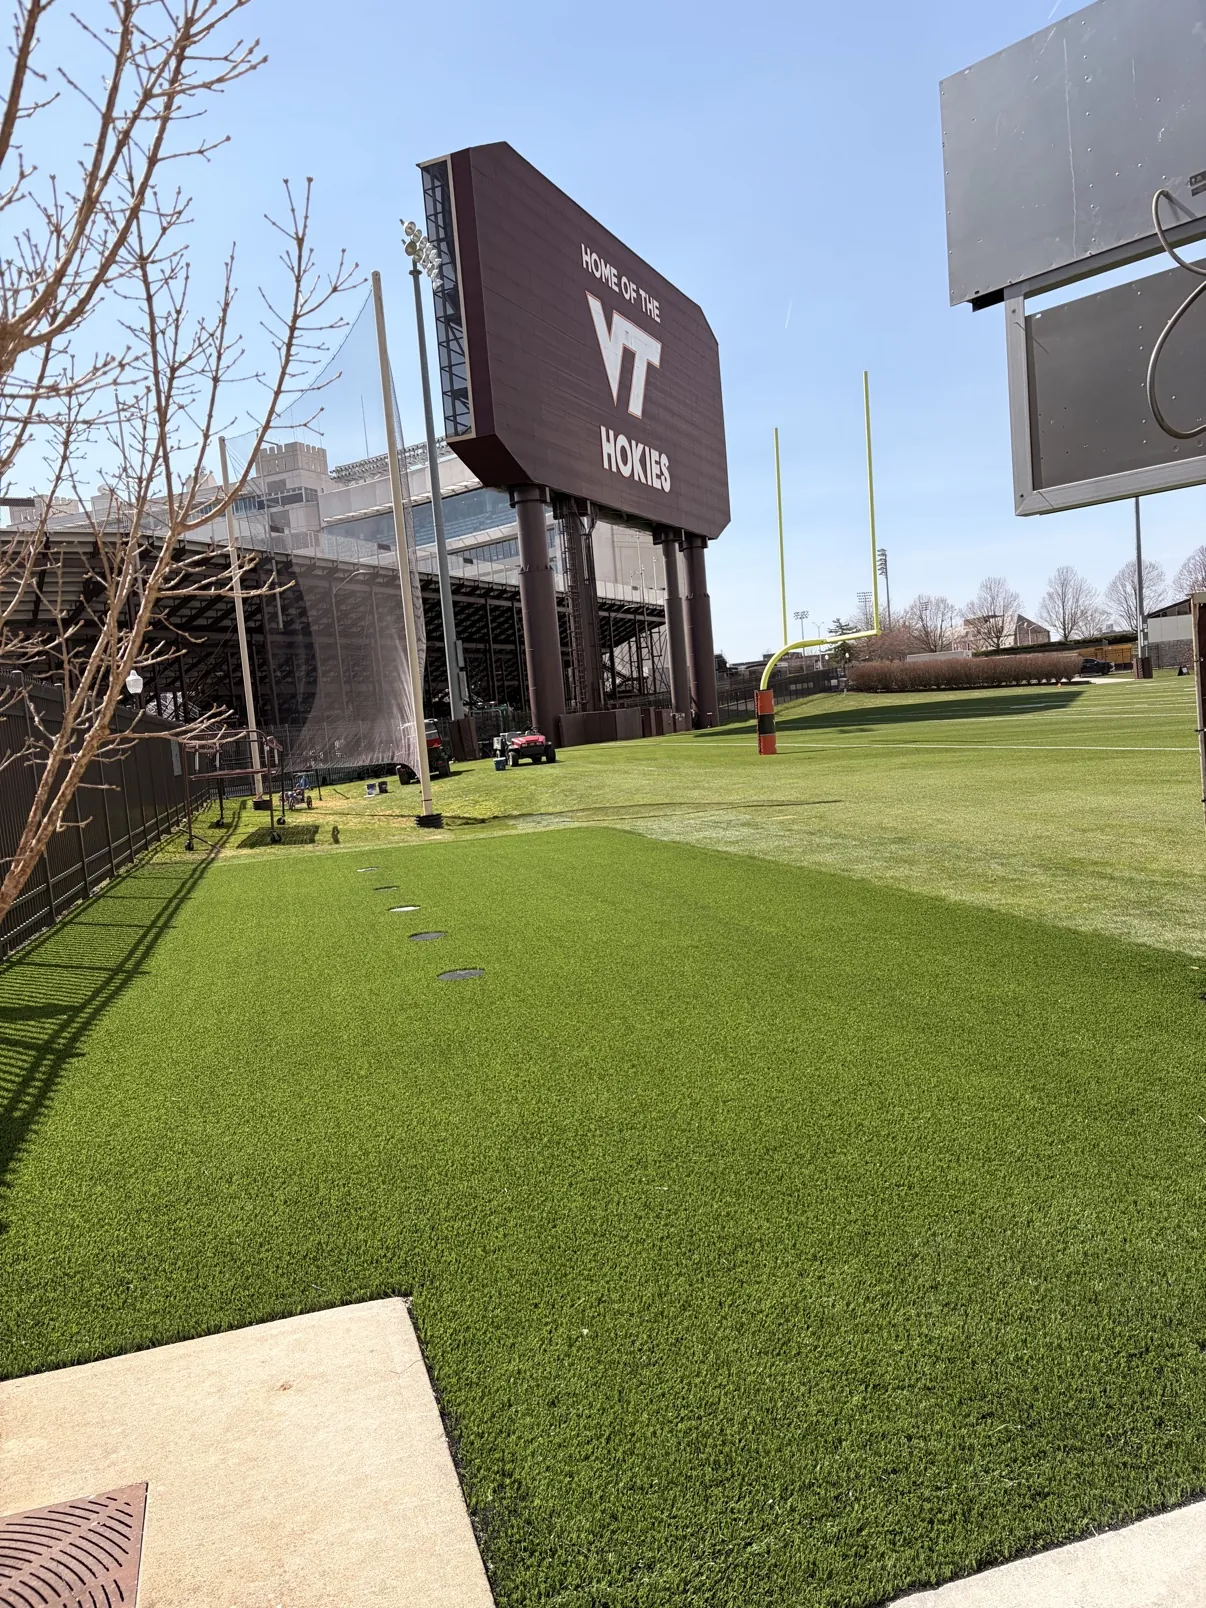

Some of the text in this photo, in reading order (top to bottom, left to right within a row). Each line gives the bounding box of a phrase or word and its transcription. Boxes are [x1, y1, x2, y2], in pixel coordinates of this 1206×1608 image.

[581, 243, 661, 323] HOME OF THE
[585, 290, 662, 419] VT
[600, 425, 671, 493] HOKIES
